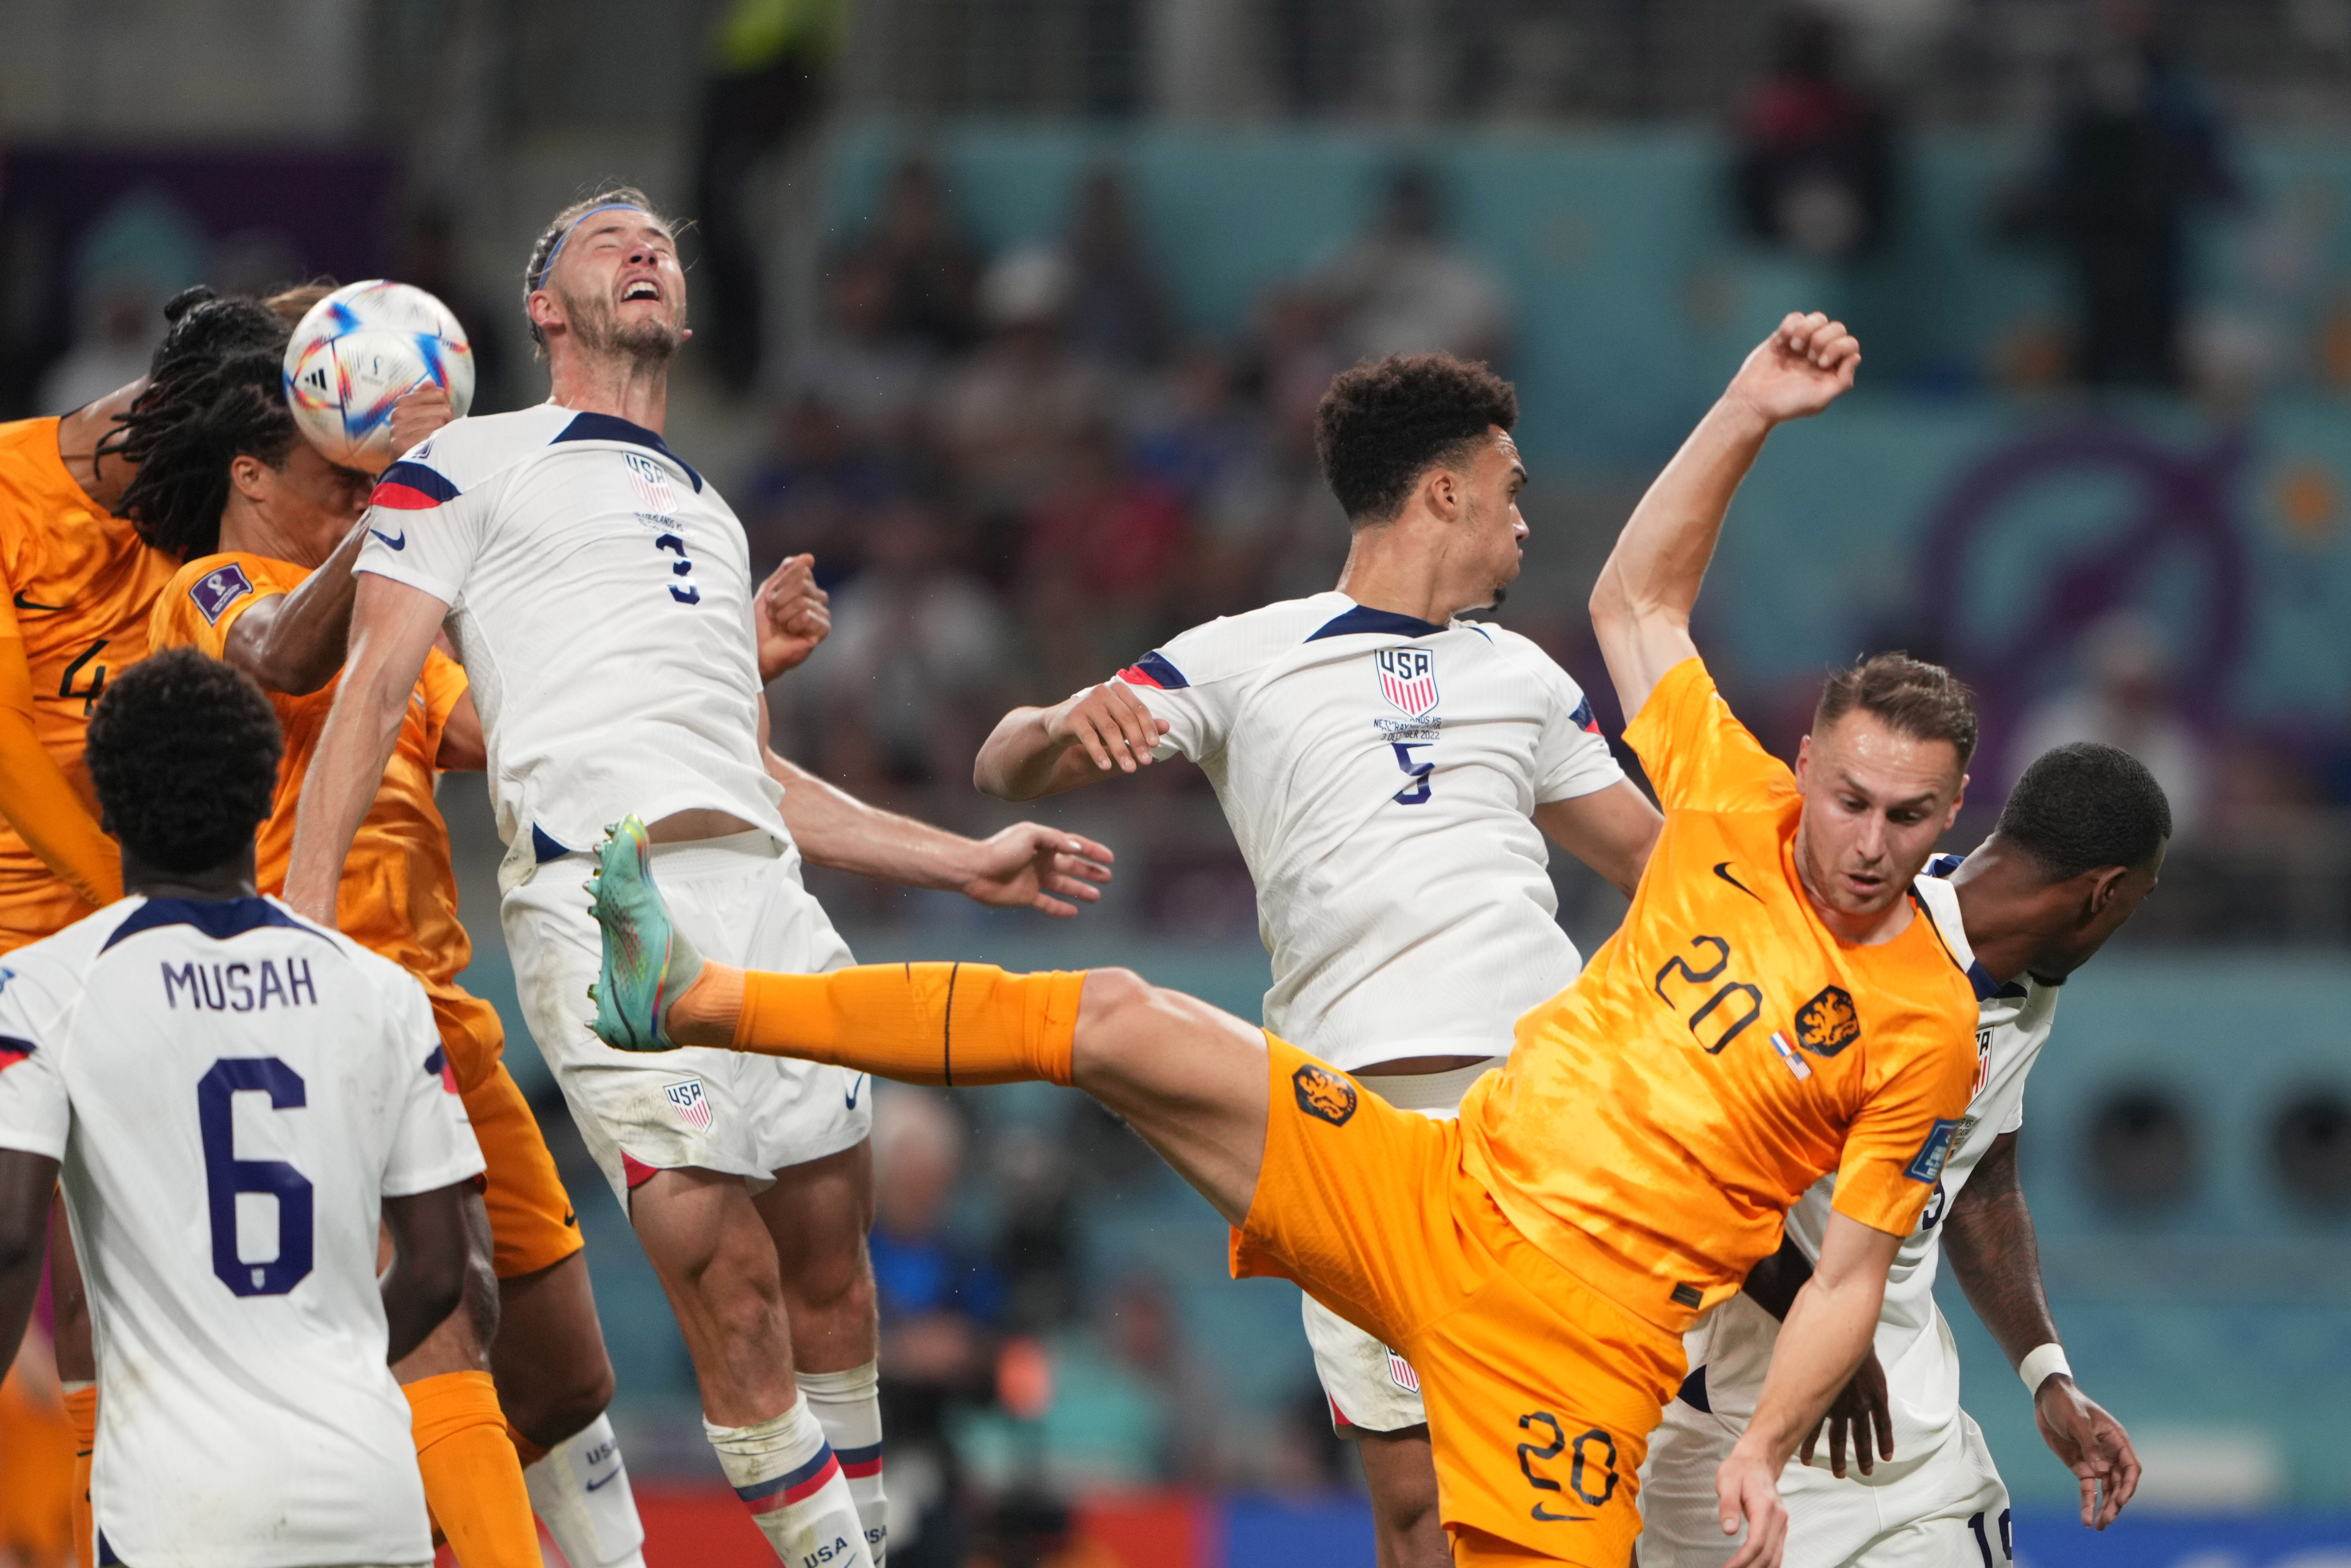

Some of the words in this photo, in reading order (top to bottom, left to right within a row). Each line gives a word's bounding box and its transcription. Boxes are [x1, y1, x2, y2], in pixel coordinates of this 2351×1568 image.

[626, 455, 665, 483] USA
[656, 534, 700, 605] 3
[59, 639, 109, 716] 4
[1380, 651, 1428, 680] USA
[1421, 730, 1440, 740] 2022
[1391, 743, 1435, 805] 5
[161, 957, 318, 1012] MUSAH
[1655, 934, 1763, 1055] 20
[668, 1083, 701, 1106] USA
[197, 1057, 313, 1298] 6
[1517, 1411, 1620, 1507] 20
[804, 1536, 848, 1568] USA
